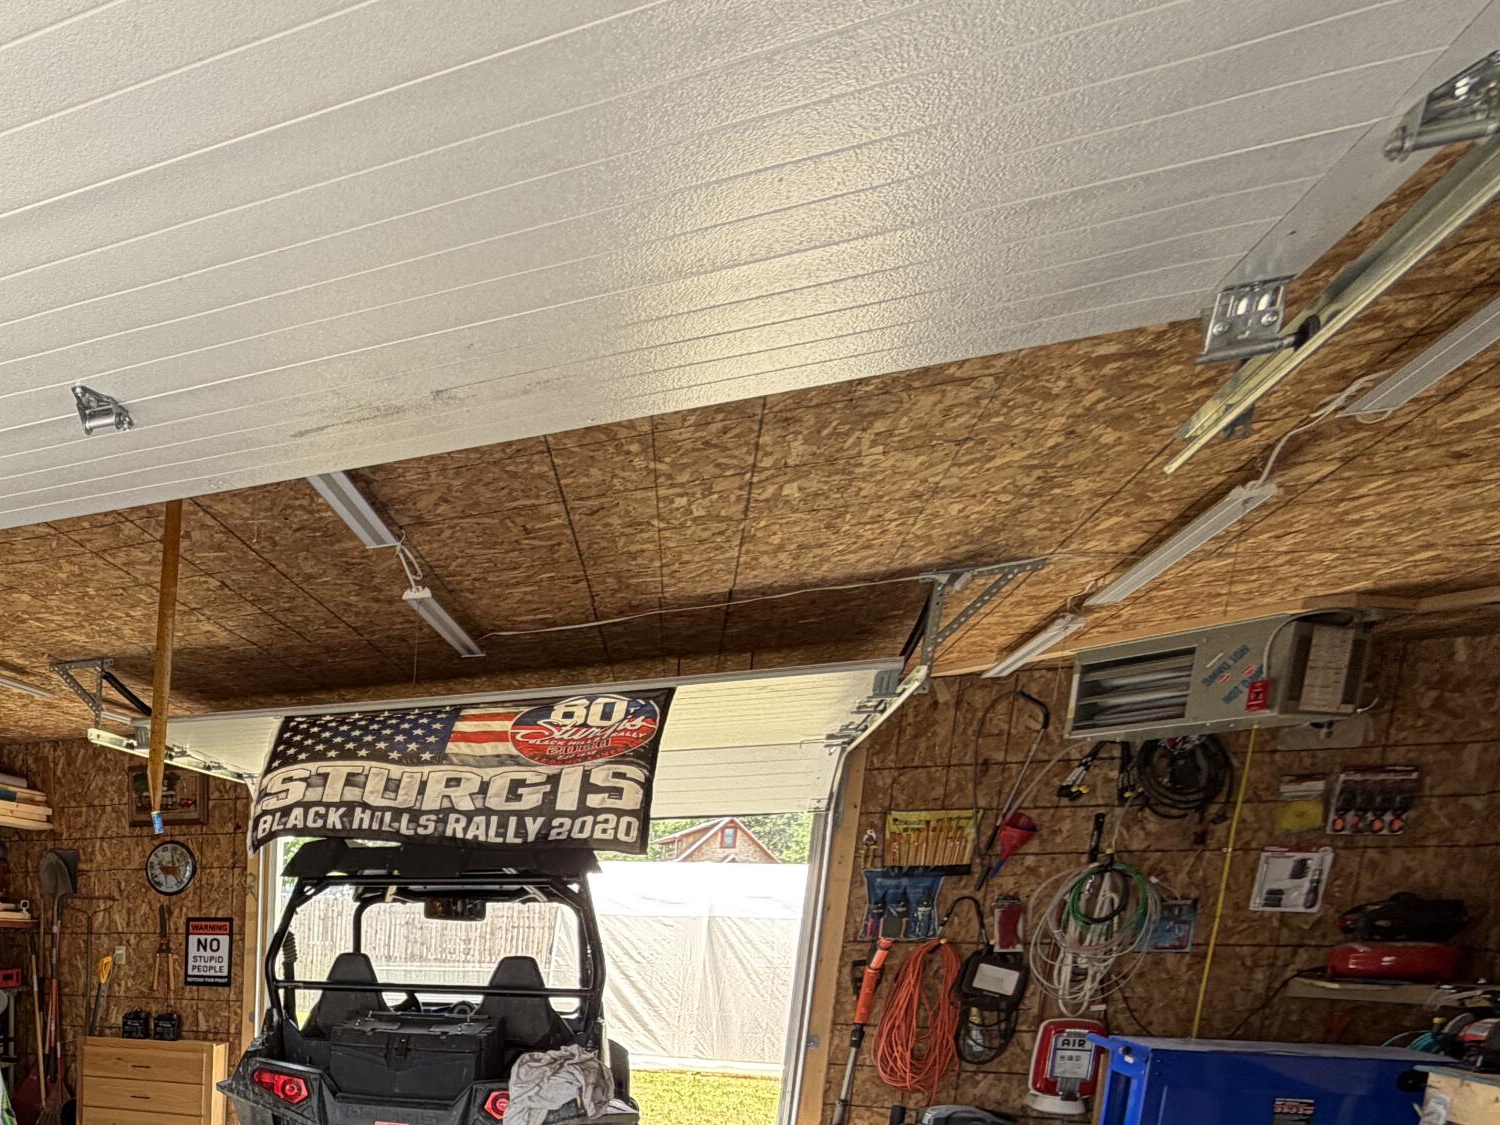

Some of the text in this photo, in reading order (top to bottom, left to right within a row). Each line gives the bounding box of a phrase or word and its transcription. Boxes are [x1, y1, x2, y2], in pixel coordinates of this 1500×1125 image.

[260, 764, 646, 812] STURGIS
[257, 806, 639, 844] BLACK HILLS RALLY 2020
[190, 924, 228, 932] WARNING
[196, 937, 221, 953] NO
[192, 954, 224, 964] STUPID
[191, 964, 225, 974] PEOPLE
[1061, 1038, 1087, 1048] AIR
